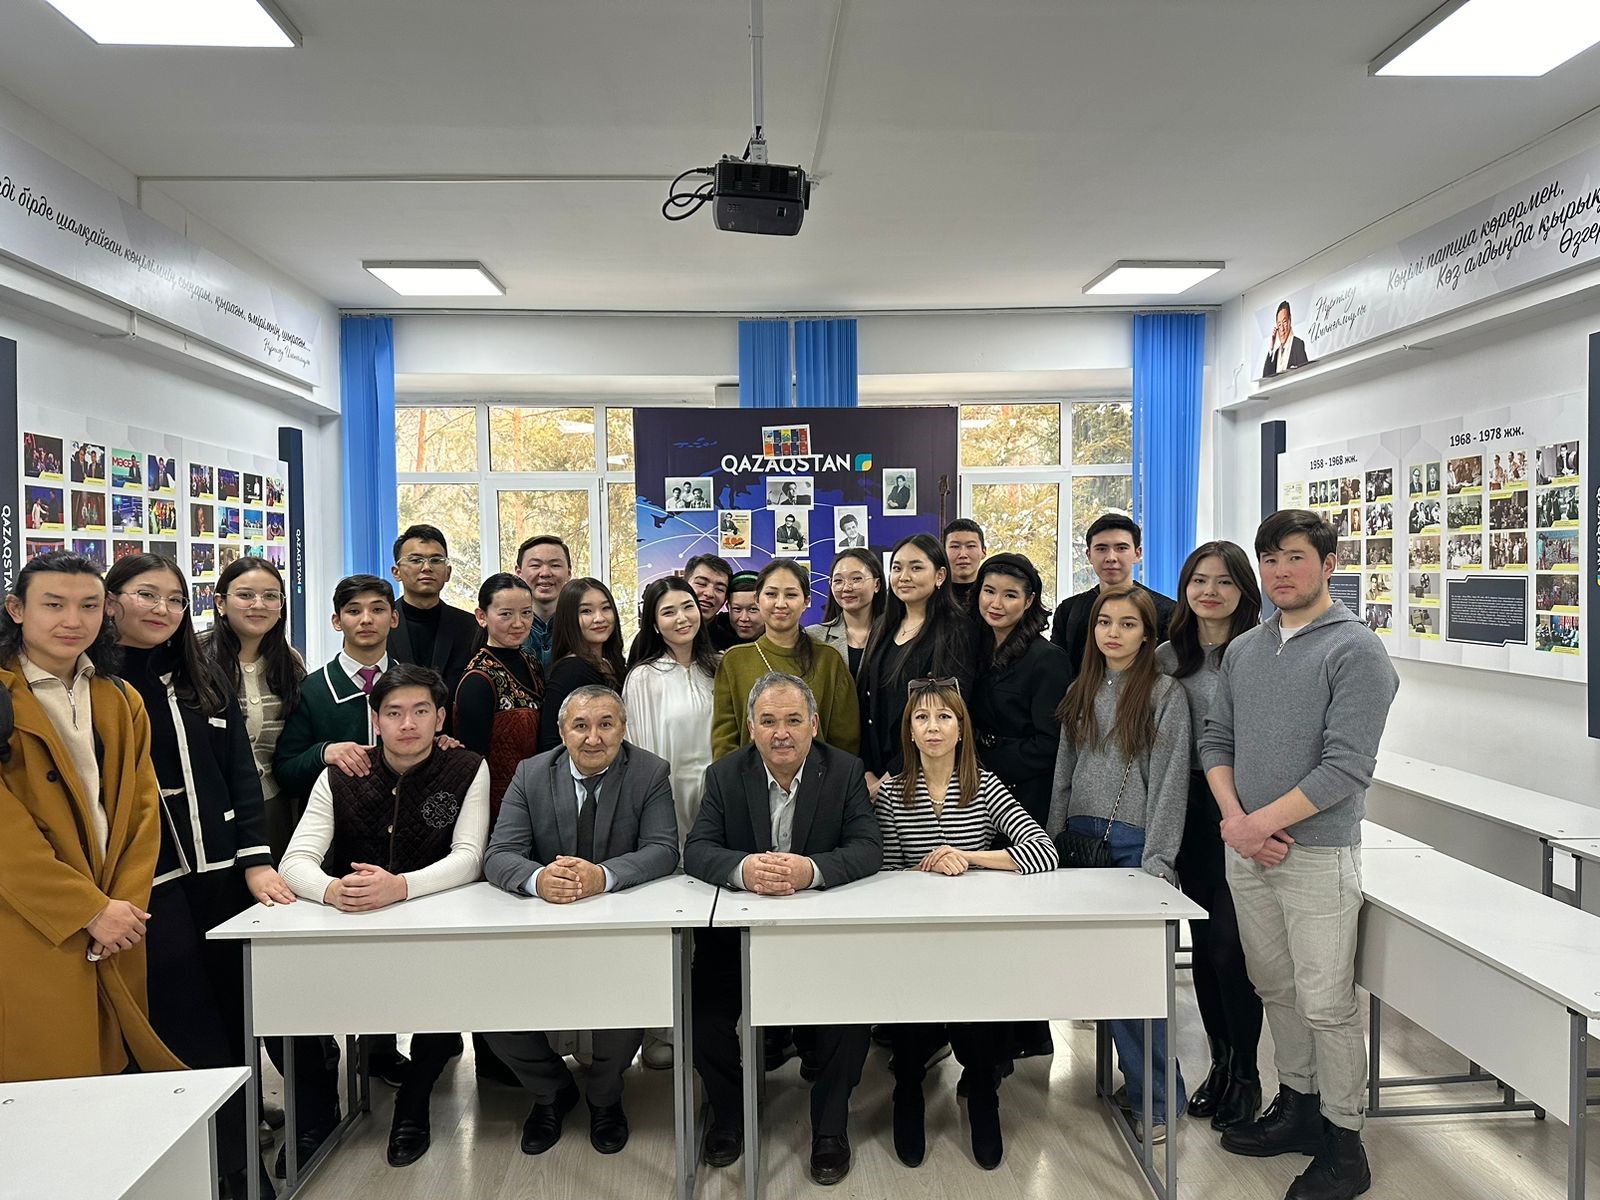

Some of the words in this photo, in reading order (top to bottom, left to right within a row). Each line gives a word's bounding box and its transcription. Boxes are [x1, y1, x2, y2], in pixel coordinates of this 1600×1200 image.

[0, 176, 15, 201] ді
[19, 187, 54, 221] бірде
[56, 211, 122, 257] шалқайған
[1387, 256, 1424, 292] Көңілі
[1427, 229, 1478, 270] патша
[1436, 263, 1460, 291] Көз
[1464, 221, 1535, 274] алдыңда
[1450, 432, 1471, 447] 1968
[1479, 427, 1502, 443] 1978
[1503, 425, 1524, 438] жж.
[721, 453, 850, 475] QAZAQSTAN
[1328, 455, 1344, 467] 1968
